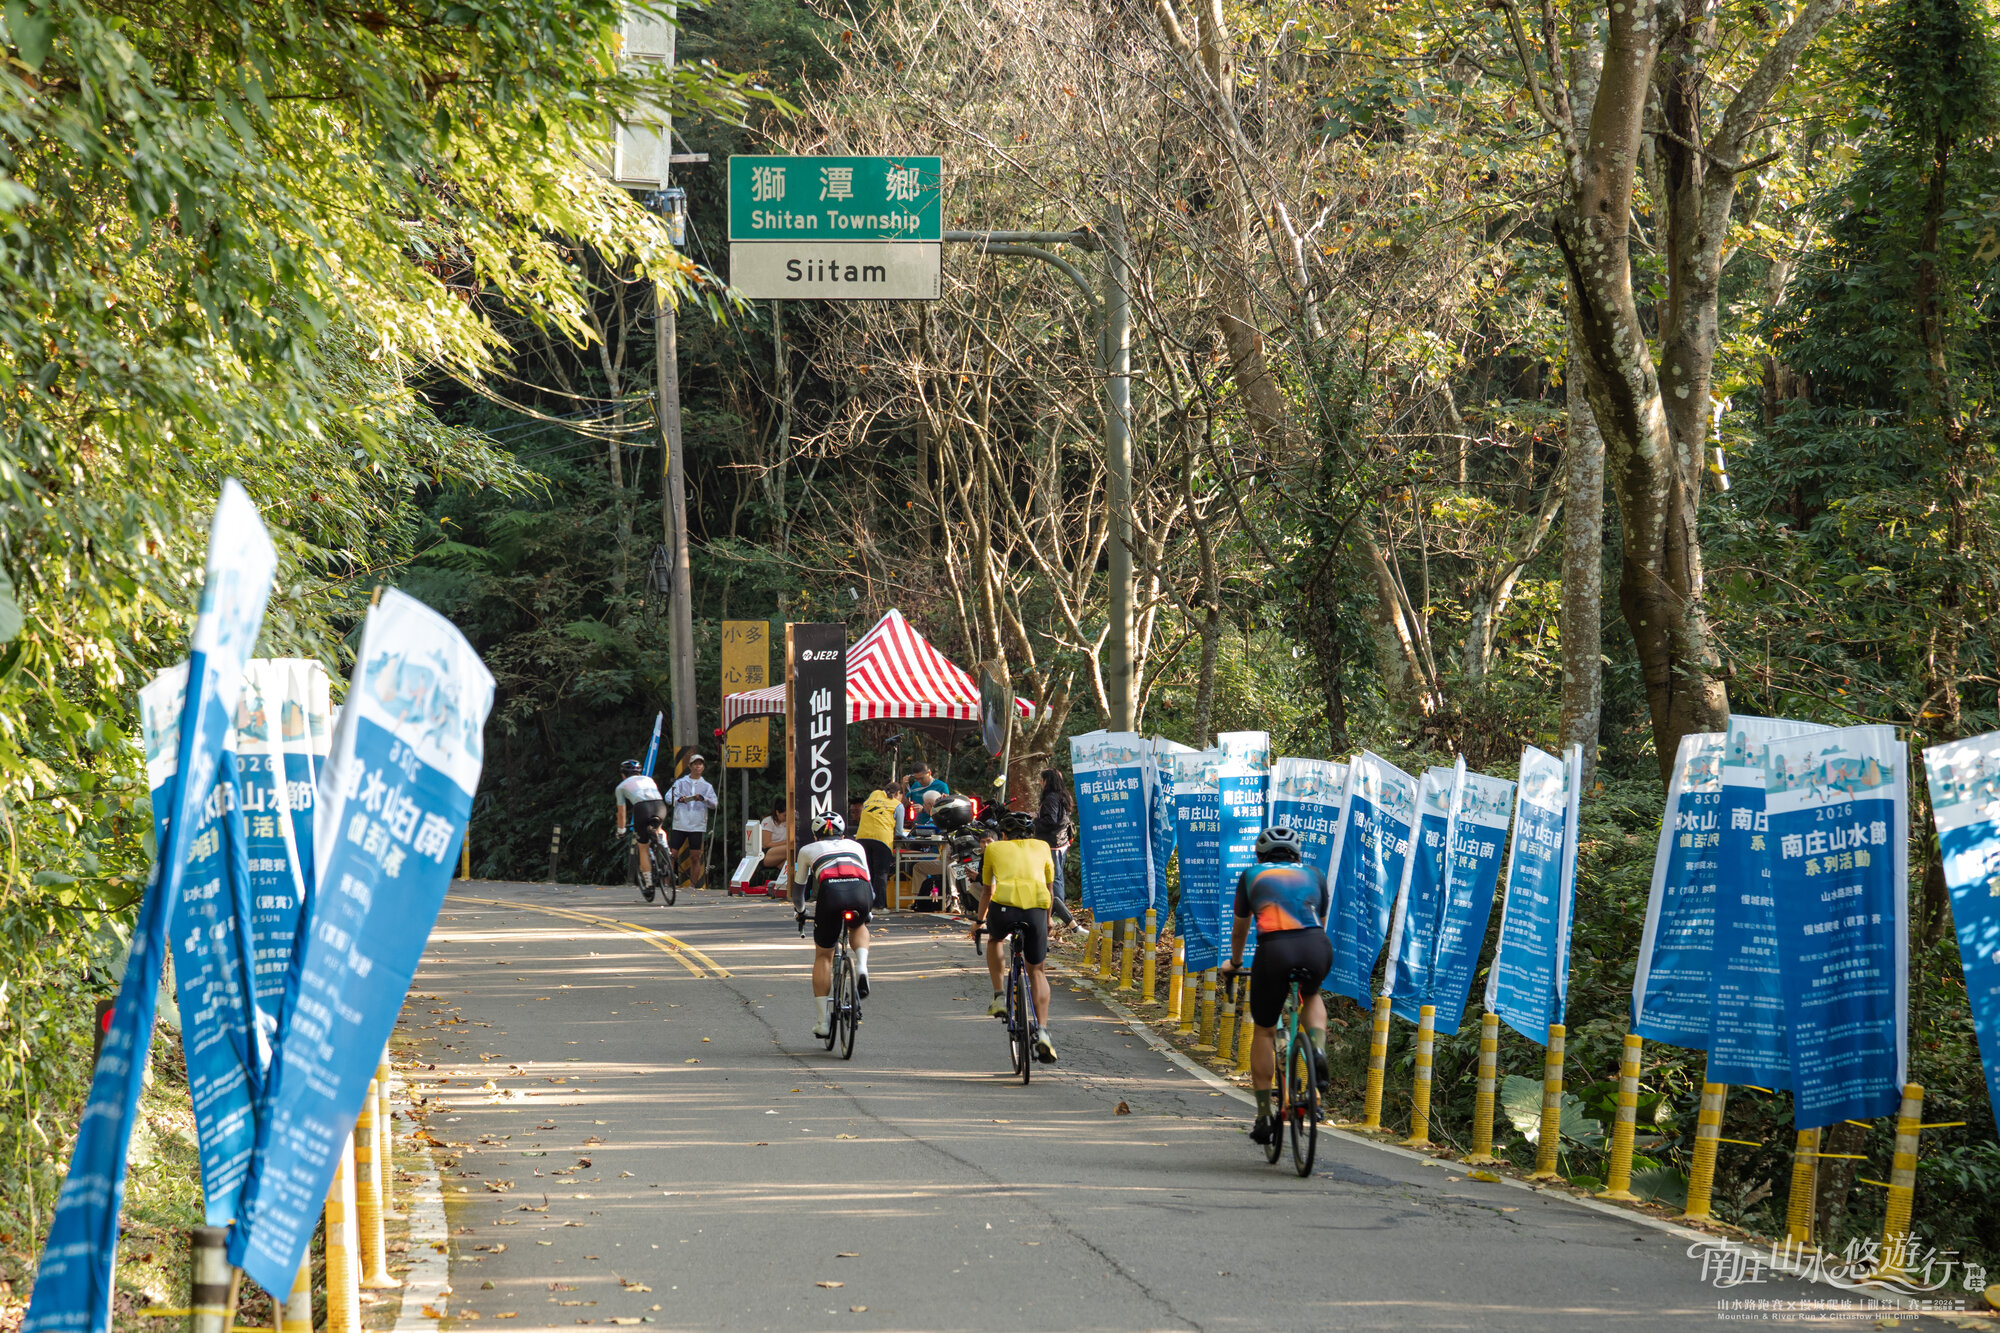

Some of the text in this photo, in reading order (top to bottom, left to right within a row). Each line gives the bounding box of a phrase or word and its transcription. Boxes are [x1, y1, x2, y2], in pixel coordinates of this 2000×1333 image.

[752, 167, 920, 202] 獅潭鄉
[752, 210, 920, 233] Shitan Township
[786, 259, 886, 282] Siitam
[813, 650, 839, 660] JE22
[745, 626, 763, 762] 多霧段
[1080, 778, 1139, 795] 南庄山水節
[1240, 777, 1258, 785] 2026
[1815, 804, 1852, 821] 2026
[1781, 820, 1887, 860] 南庄山水節
[1805, 850, 1871, 876] 系列活動
